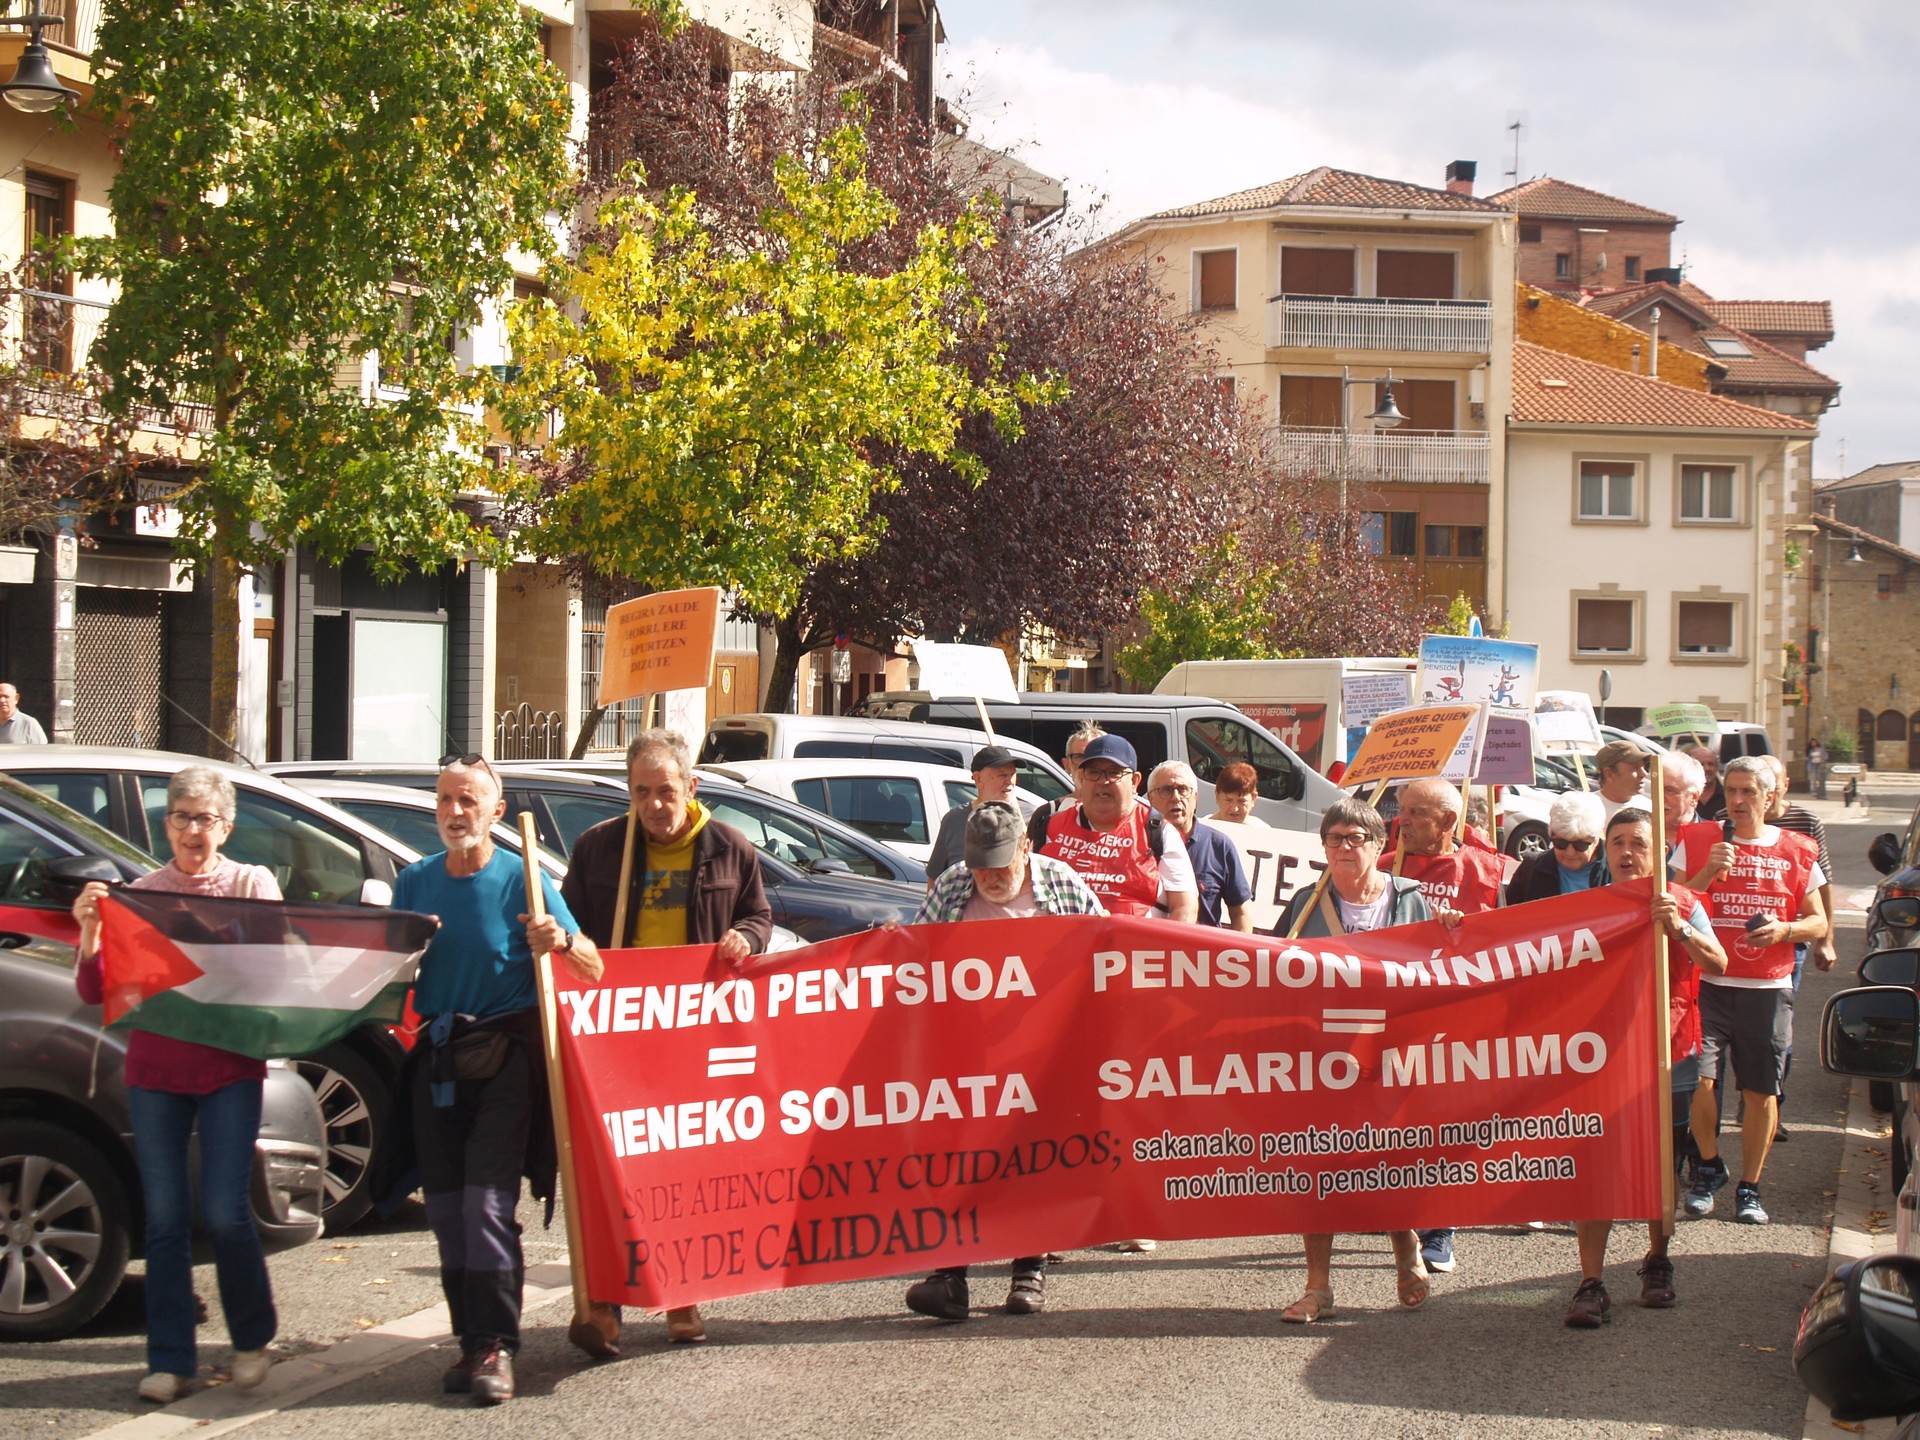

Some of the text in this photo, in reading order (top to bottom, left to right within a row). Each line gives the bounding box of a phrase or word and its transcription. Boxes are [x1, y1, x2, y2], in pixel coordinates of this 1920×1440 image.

[620, 600, 700, 625] BEGIRA ZAUDE
[663, 619, 687, 631] ERE
[631, 656, 671, 673] DIZUTE
[1240, 708, 1262, 717] EJADOS
[1267, 708, 1297, 717] REFORMAS
[1374, 711, 1470, 732] GOBIERNE QUIEN
[1385, 724, 1443, 739] GOBIERNE
[1392, 737, 1419, 747] LAS
[1363, 748, 1436, 766] PENSIONES
[1350, 760, 1440, 778] SE DEFIENDEN
[1729, 866, 1783, 880] ENTSIOA
[1416, 881, 1459, 898] SIÓN
[1093, 927, 1605, 992] PENSIÓN MÍNIMA
[558, 955, 1038, 1037] XIENEKO PENTSIOA
[1097, 1030, 1608, 1101] SALARIO MÍNIMO
[602, 1072, 1038, 1159] IENEKO SOLDATA
[1133, 1107, 1604, 1163] sakanako pentsiodunen mugimendua
[650, 1182, 683, 1223] DE
[691, 1156, 852, 1217] ATENCIÓN
[863, 1156, 887, 1194] Y
[896, 1129, 1122, 1192] CUIDADOS;
[1164, 1151, 1576, 1201] movimiento pensionistas sakana
[673, 1238, 693, 1284] Y
[701, 1230, 745, 1281] DE
[756, 1204, 982, 1272] CALIDAD!!
